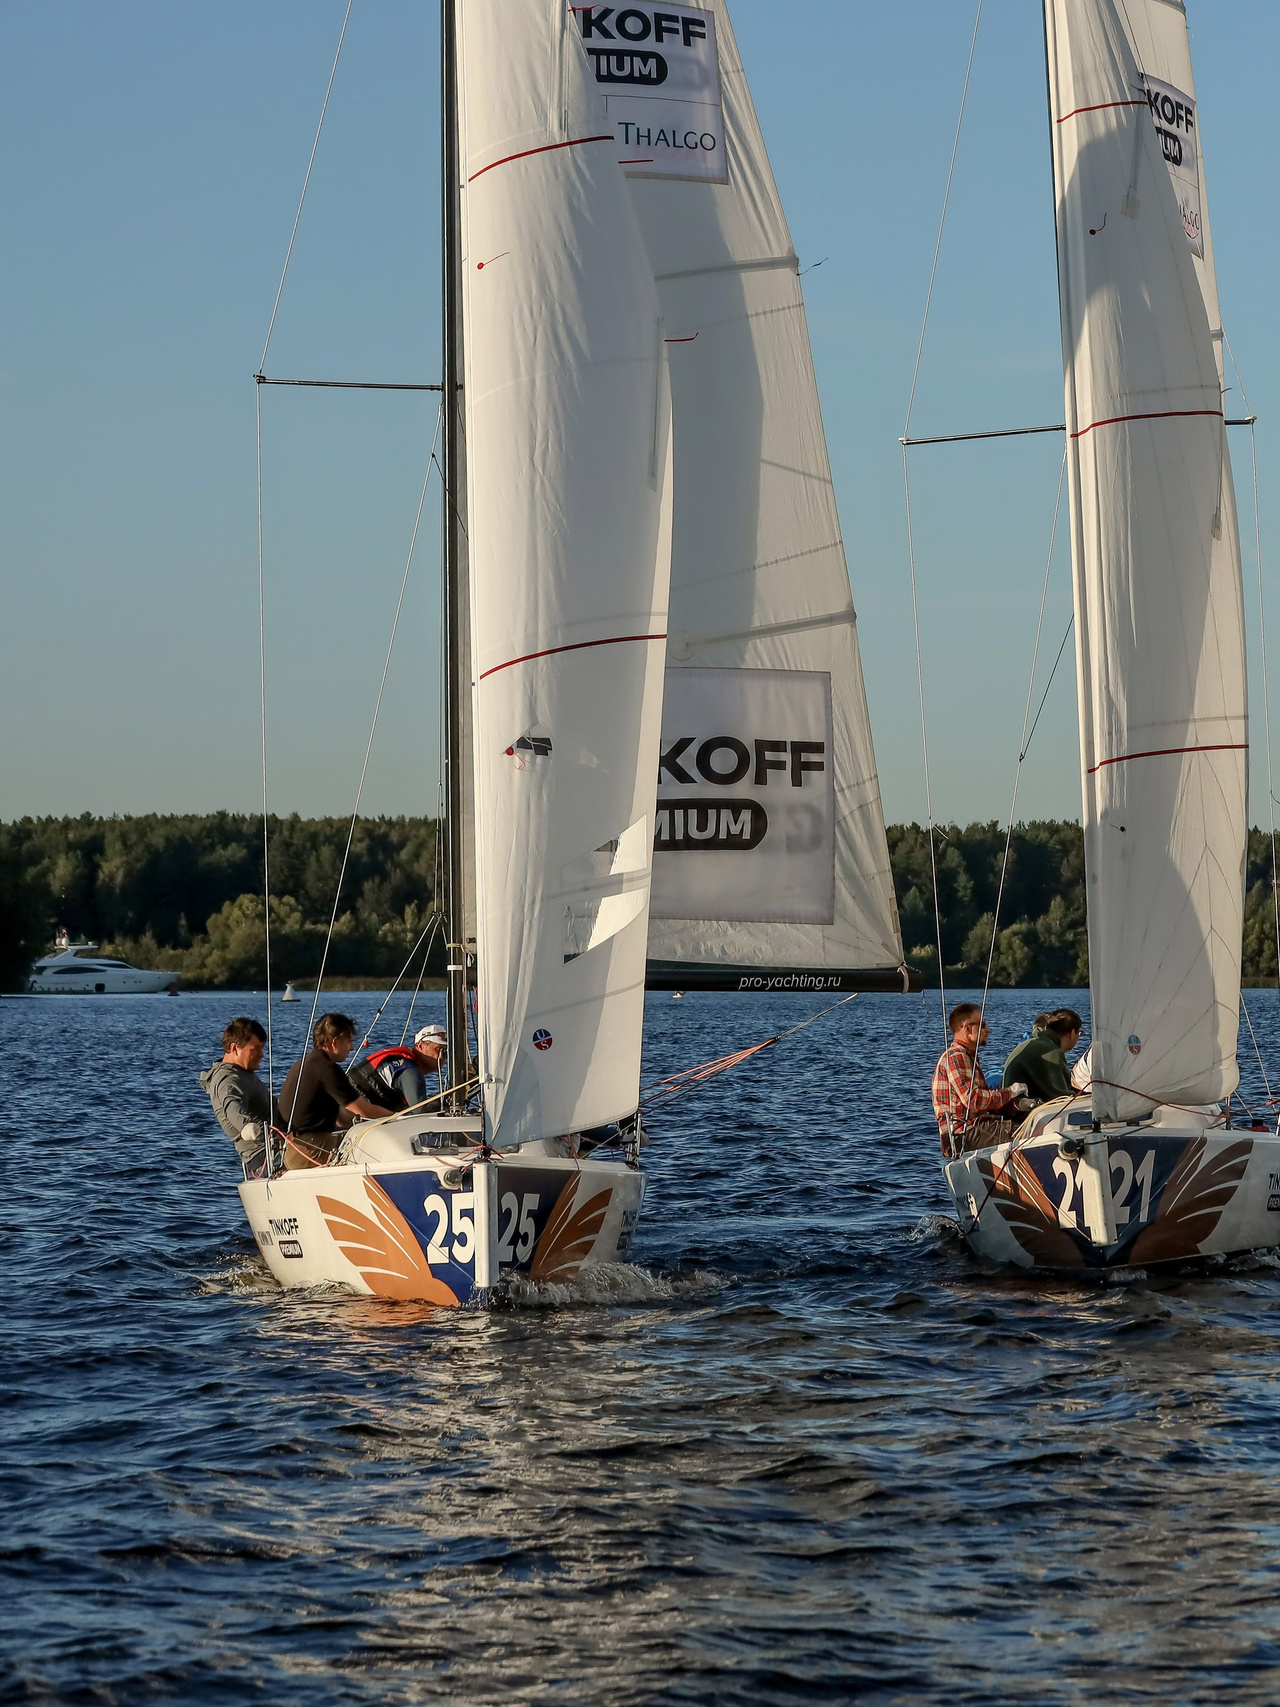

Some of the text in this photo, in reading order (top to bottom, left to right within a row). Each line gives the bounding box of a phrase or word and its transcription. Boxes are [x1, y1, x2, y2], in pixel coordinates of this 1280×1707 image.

[582, 8, 706, 47] KOFF
[1147, 88, 1194, 134] KOFF
[618, 121, 717, 151] THALGO
[658, 735, 825, 787] KOFF
[738, 974, 842, 991] pro-yachting.ru
[1109, 1149, 1155, 1224] 21
[423, 1193, 475, 1265] 25
[499, 1191, 540, 1262] 25
